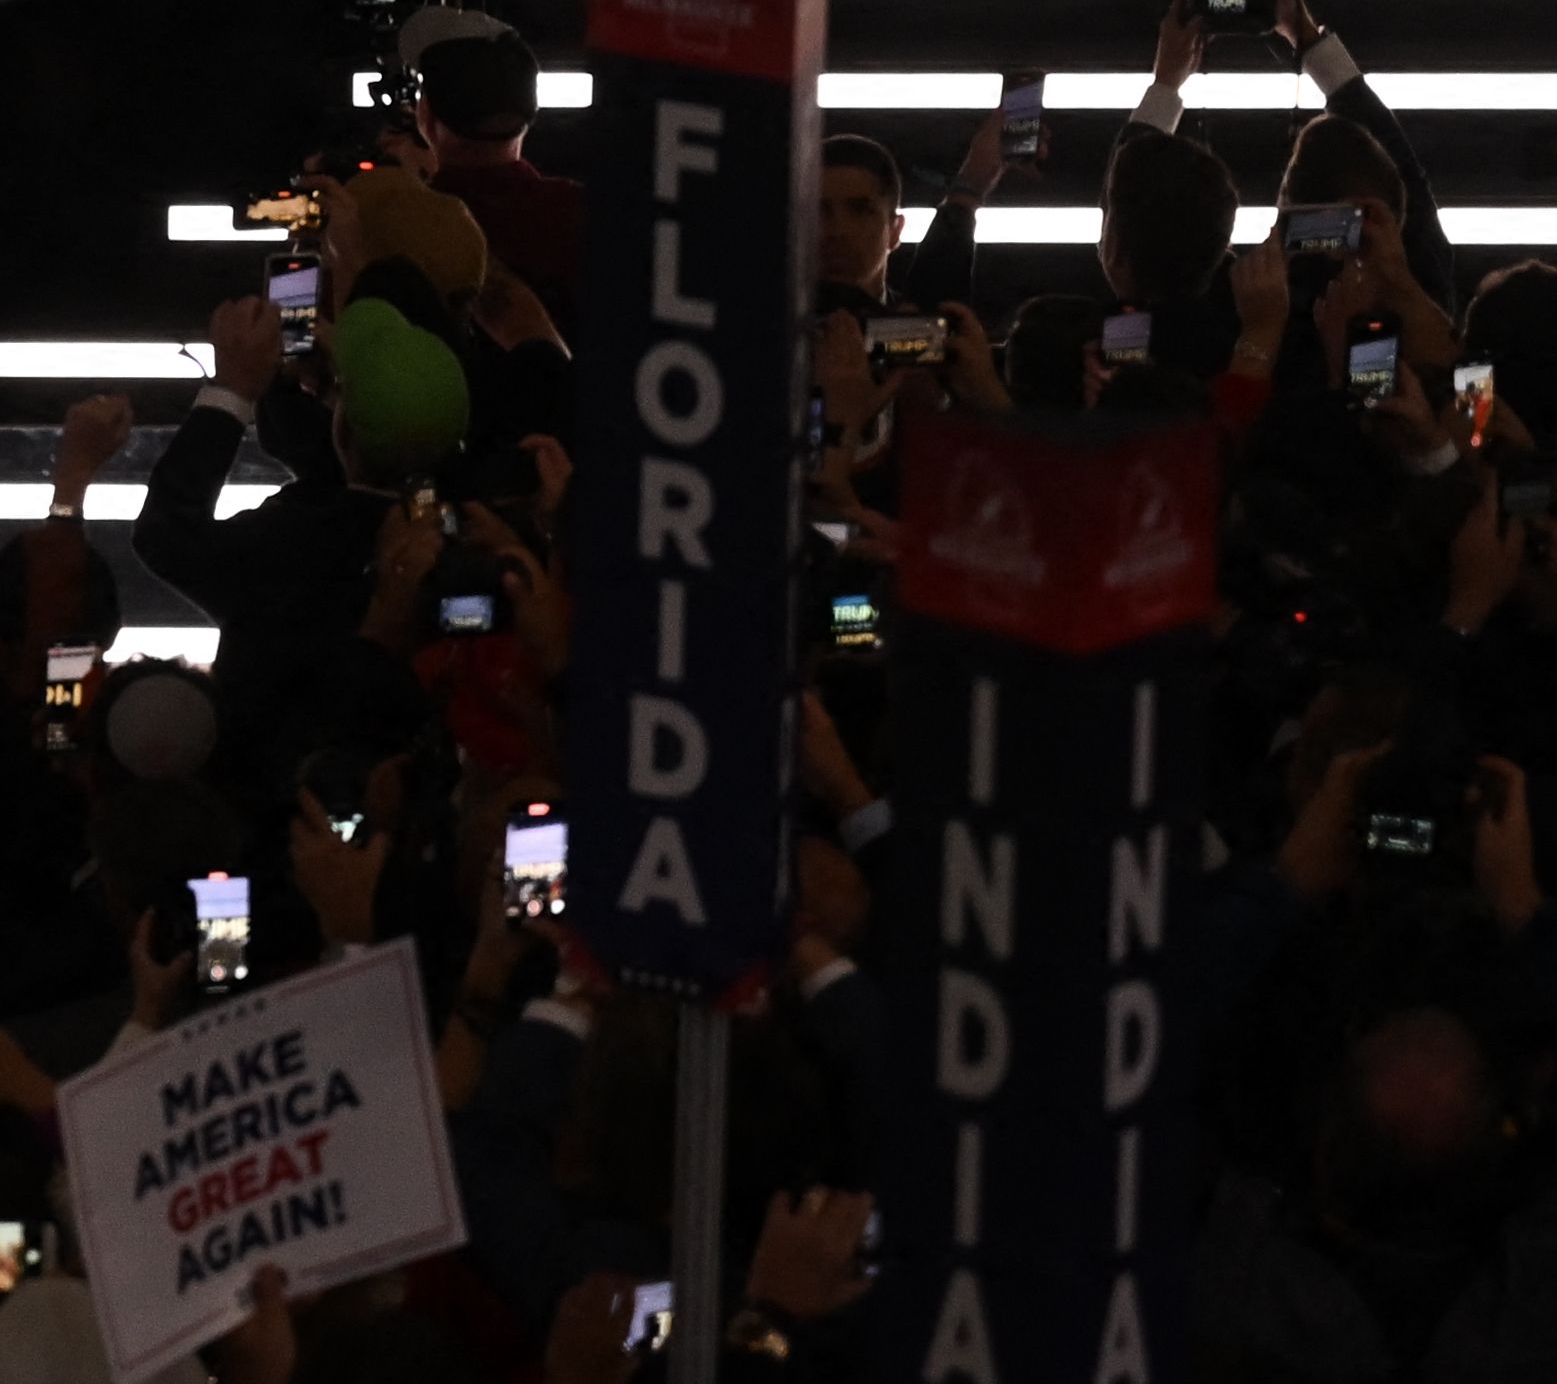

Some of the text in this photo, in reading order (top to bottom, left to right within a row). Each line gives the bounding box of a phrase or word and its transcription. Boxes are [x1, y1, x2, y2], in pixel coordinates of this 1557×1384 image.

[618, 96, 726, 928] FLORIDA
[133, 1068, 362, 1201] AMERICA
[160, 1029, 309, 1127] MAKE
[167, 1131, 331, 1234] GREAT
[176, 1182, 349, 1296] AGAIN!
